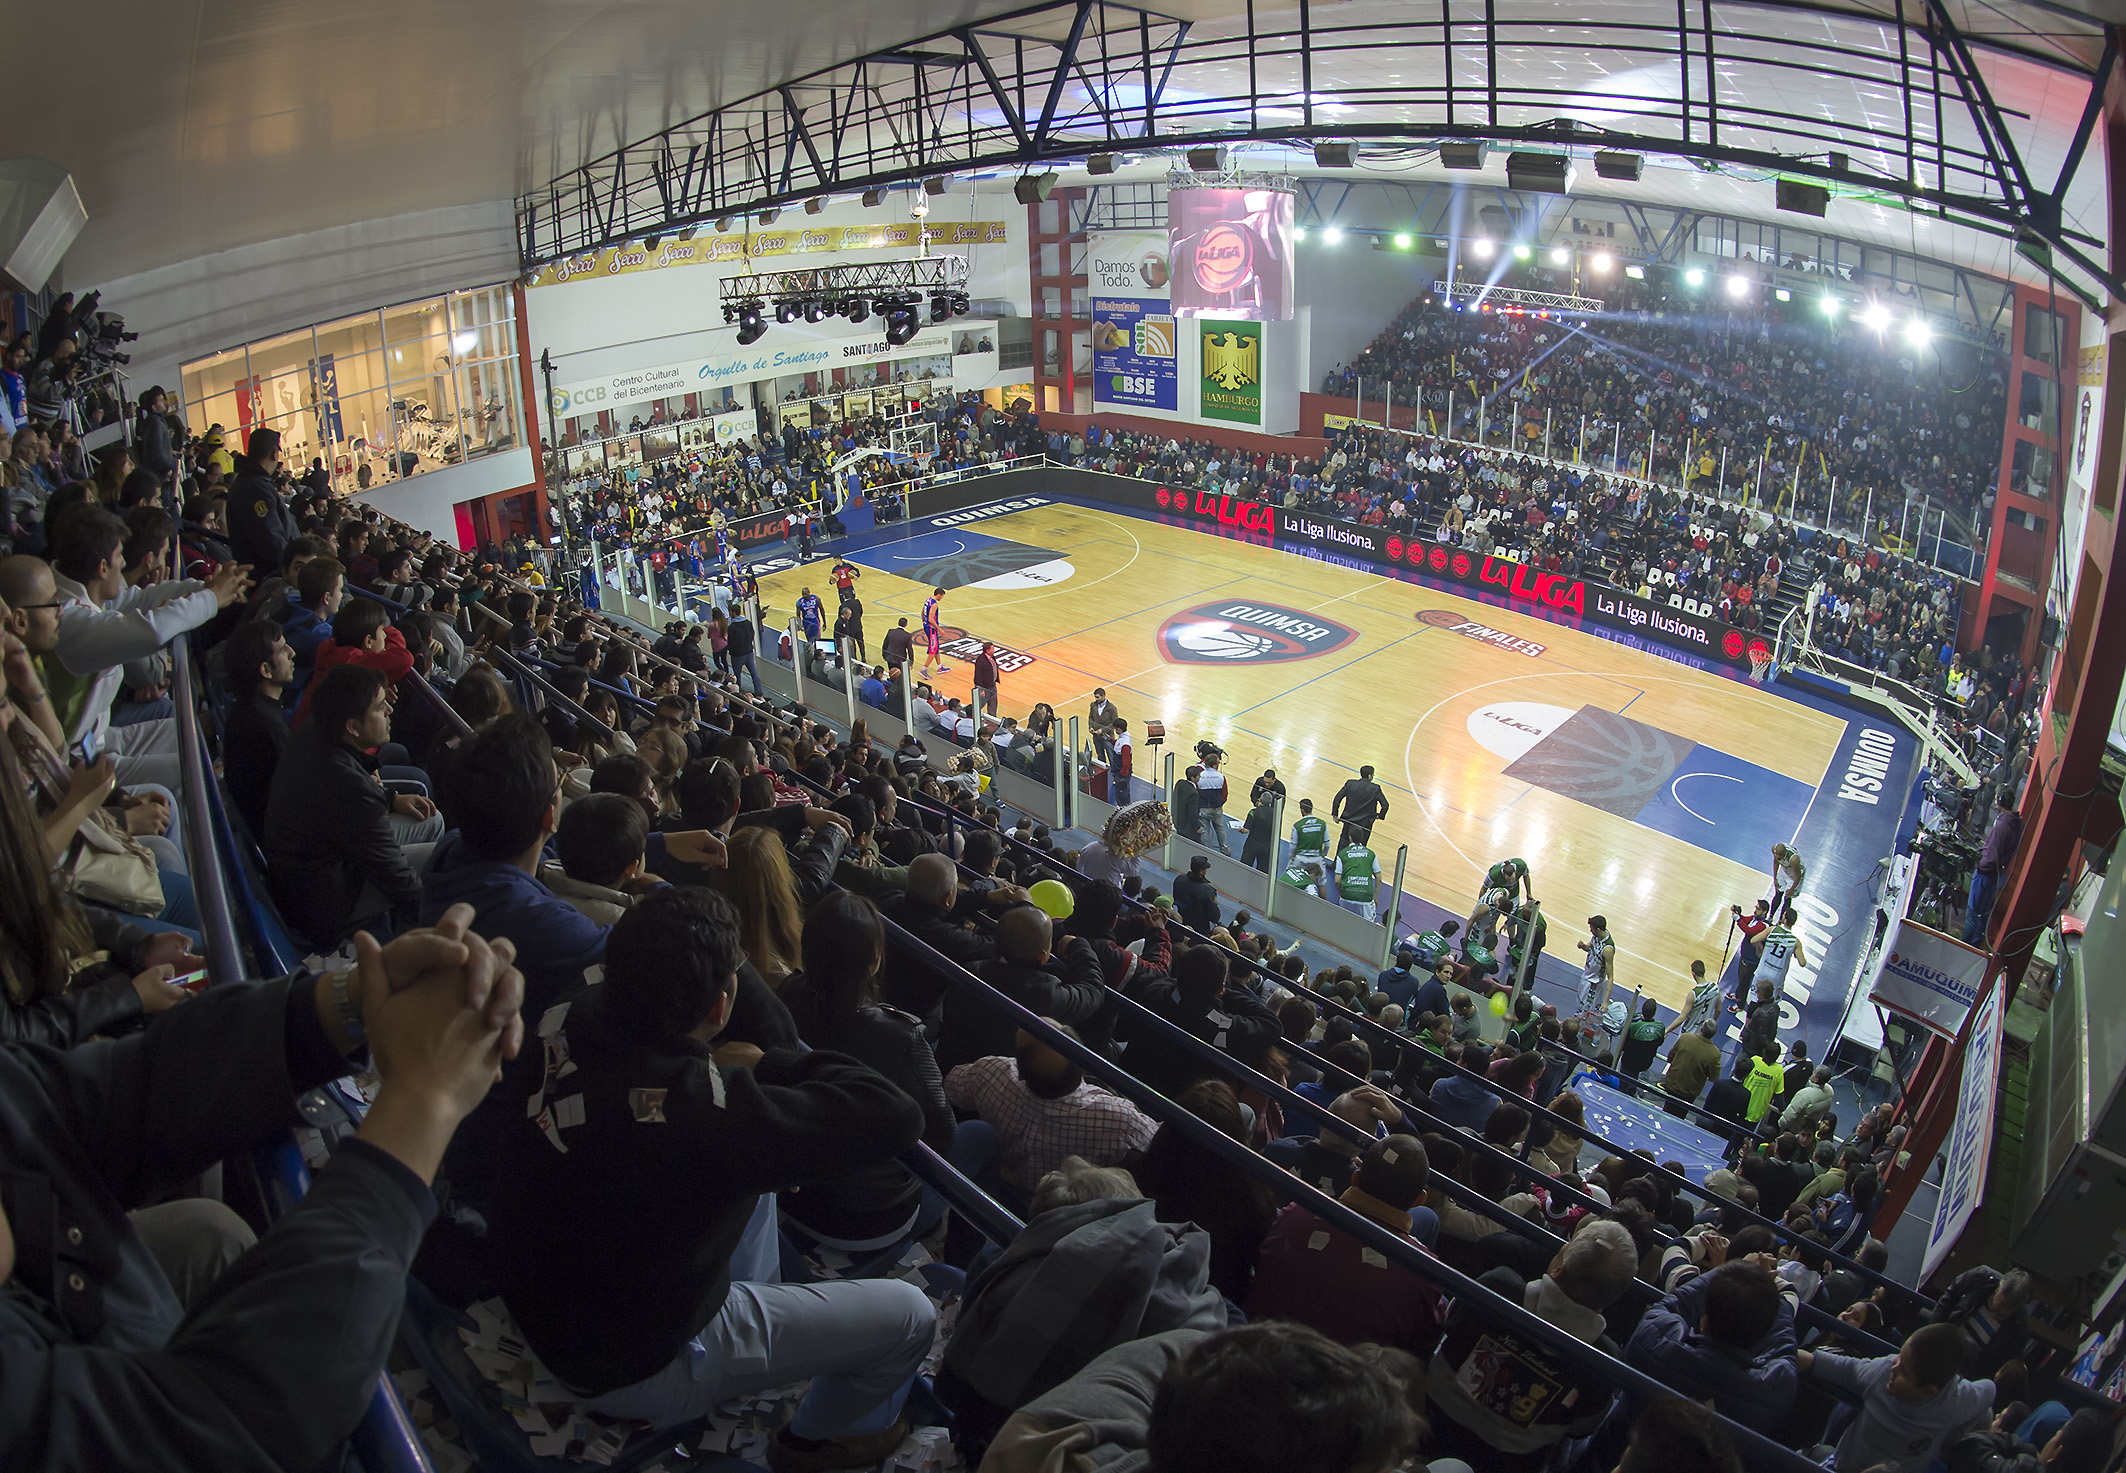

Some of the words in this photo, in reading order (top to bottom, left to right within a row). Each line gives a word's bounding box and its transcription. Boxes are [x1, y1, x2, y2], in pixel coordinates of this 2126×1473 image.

[609, 251, 646, 274] Secco
[658, 243, 695, 267] Secco
[706, 238, 741, 261] Secco
[752, 234, 786, 256] Secco
[796, 230, 829, 253] Secco
[839, 228, 870, 249] Secco
[880, 226, 909, 249] Secco
[917, 224, 944, 244] Scco
[953, 223, 979, 243] Secco
[985, 223, 1007, 242] Secc
[1095, 259, 1136, 273] Damos
[1100, 273, 1133, 287] Todo.
[612, 376, 643, 388] Centro
[645, 368, 680, 382] Cultural
[698, 360, 748, 381] Orgullo
[752, 357, 767, 369] de
[773, 351, 829, 367] Santiago
[573, 386, 607, 405] CCB
[613, 390, 628, 400] del
[629, 380, 685, 397] Bicentenario
[1123, 375, 1156, 396] BSE
[1202, 391, 1259, 408] HAMBURGO
[734, 419, 756, 432] CCB
[930, 497, 1051, 527] QUIMSA
[1284, 515, 1298, 533] La
[1300, 519, 1324, 540] Liga
[1326, 523, 1376, 551] Ilusiona.
[1218, 605, 1331, 642] QUIMSA
[1596, 594, 1615, 615] La
[1617, 600, 1648, 626] Liga
[1650, 609, 1710, 645] Ilusiona.
[1448, 621, 1545, 657] FINALES
[1837, 728, 1896, 805] QUIMSA
[1769, 942, 1787, 960] 13
[1897, 957, 1979, 1000] AMUQUIM
[1939, 988, 1969, 1006] MUTUAL
[1948, 1028, 1991, 1226] AMUQUIM
